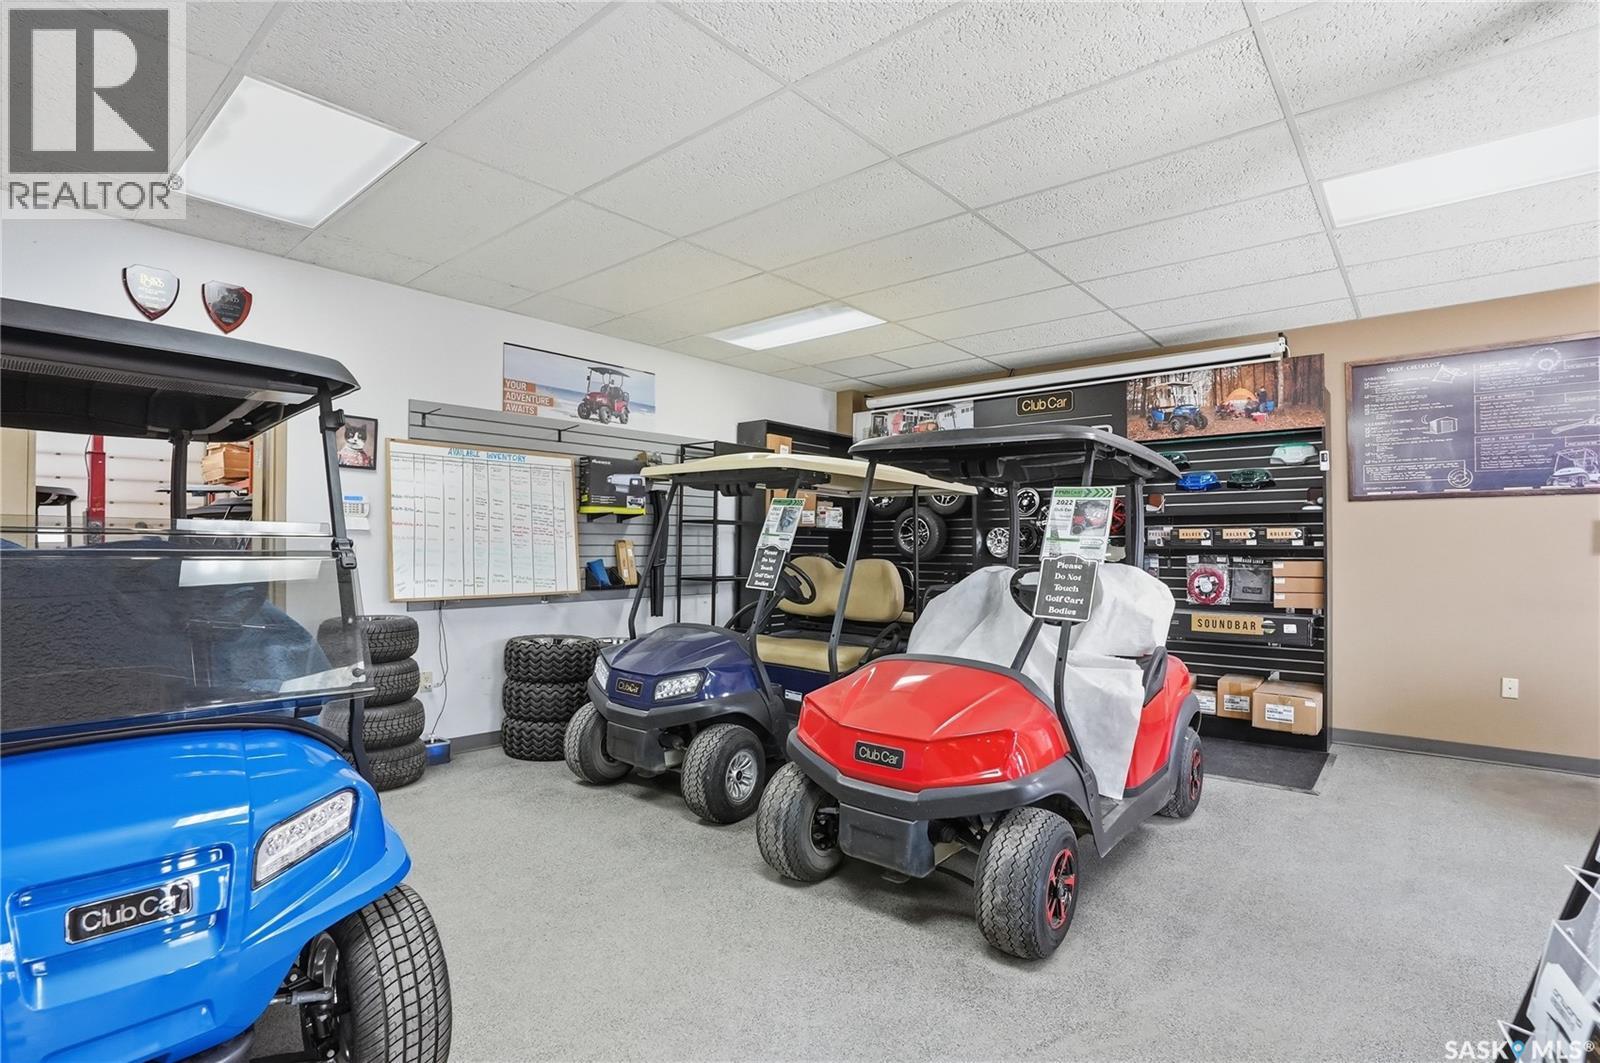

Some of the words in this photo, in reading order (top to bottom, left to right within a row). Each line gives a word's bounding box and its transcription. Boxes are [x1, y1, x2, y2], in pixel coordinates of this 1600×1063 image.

[505, 381, 527, 391] YOUR
[505, 393, 551, 406] ADVENTURE
[1021, 399, 1046, 412] Club
[1047, 396, 1068, 409] Car
[505, 403, 535, 415] AWAITS
[448, 447, 480, 458] AVAILABLE
[486, 452, 527, 464] INVENTORY
[1056, 561, 1083, 570] Please
[1067, 573, 1082, 581] Not
[1054, 584, 1079, 593] Touch
[1045, 595, 1064, 603] Golf
[1064, 596, 1084, 605] Cart
[1048, 606, 1077, 616] Bodies
[1197, 618, 1257, 631] SOUNDBAR
[629, 683, 640, 693] Car
[858, 746, 880, 761] Club
[881, 751, 899, 765] Car
[82, 903, 137, 932] Club
[139, 893, 181, 917] Car
